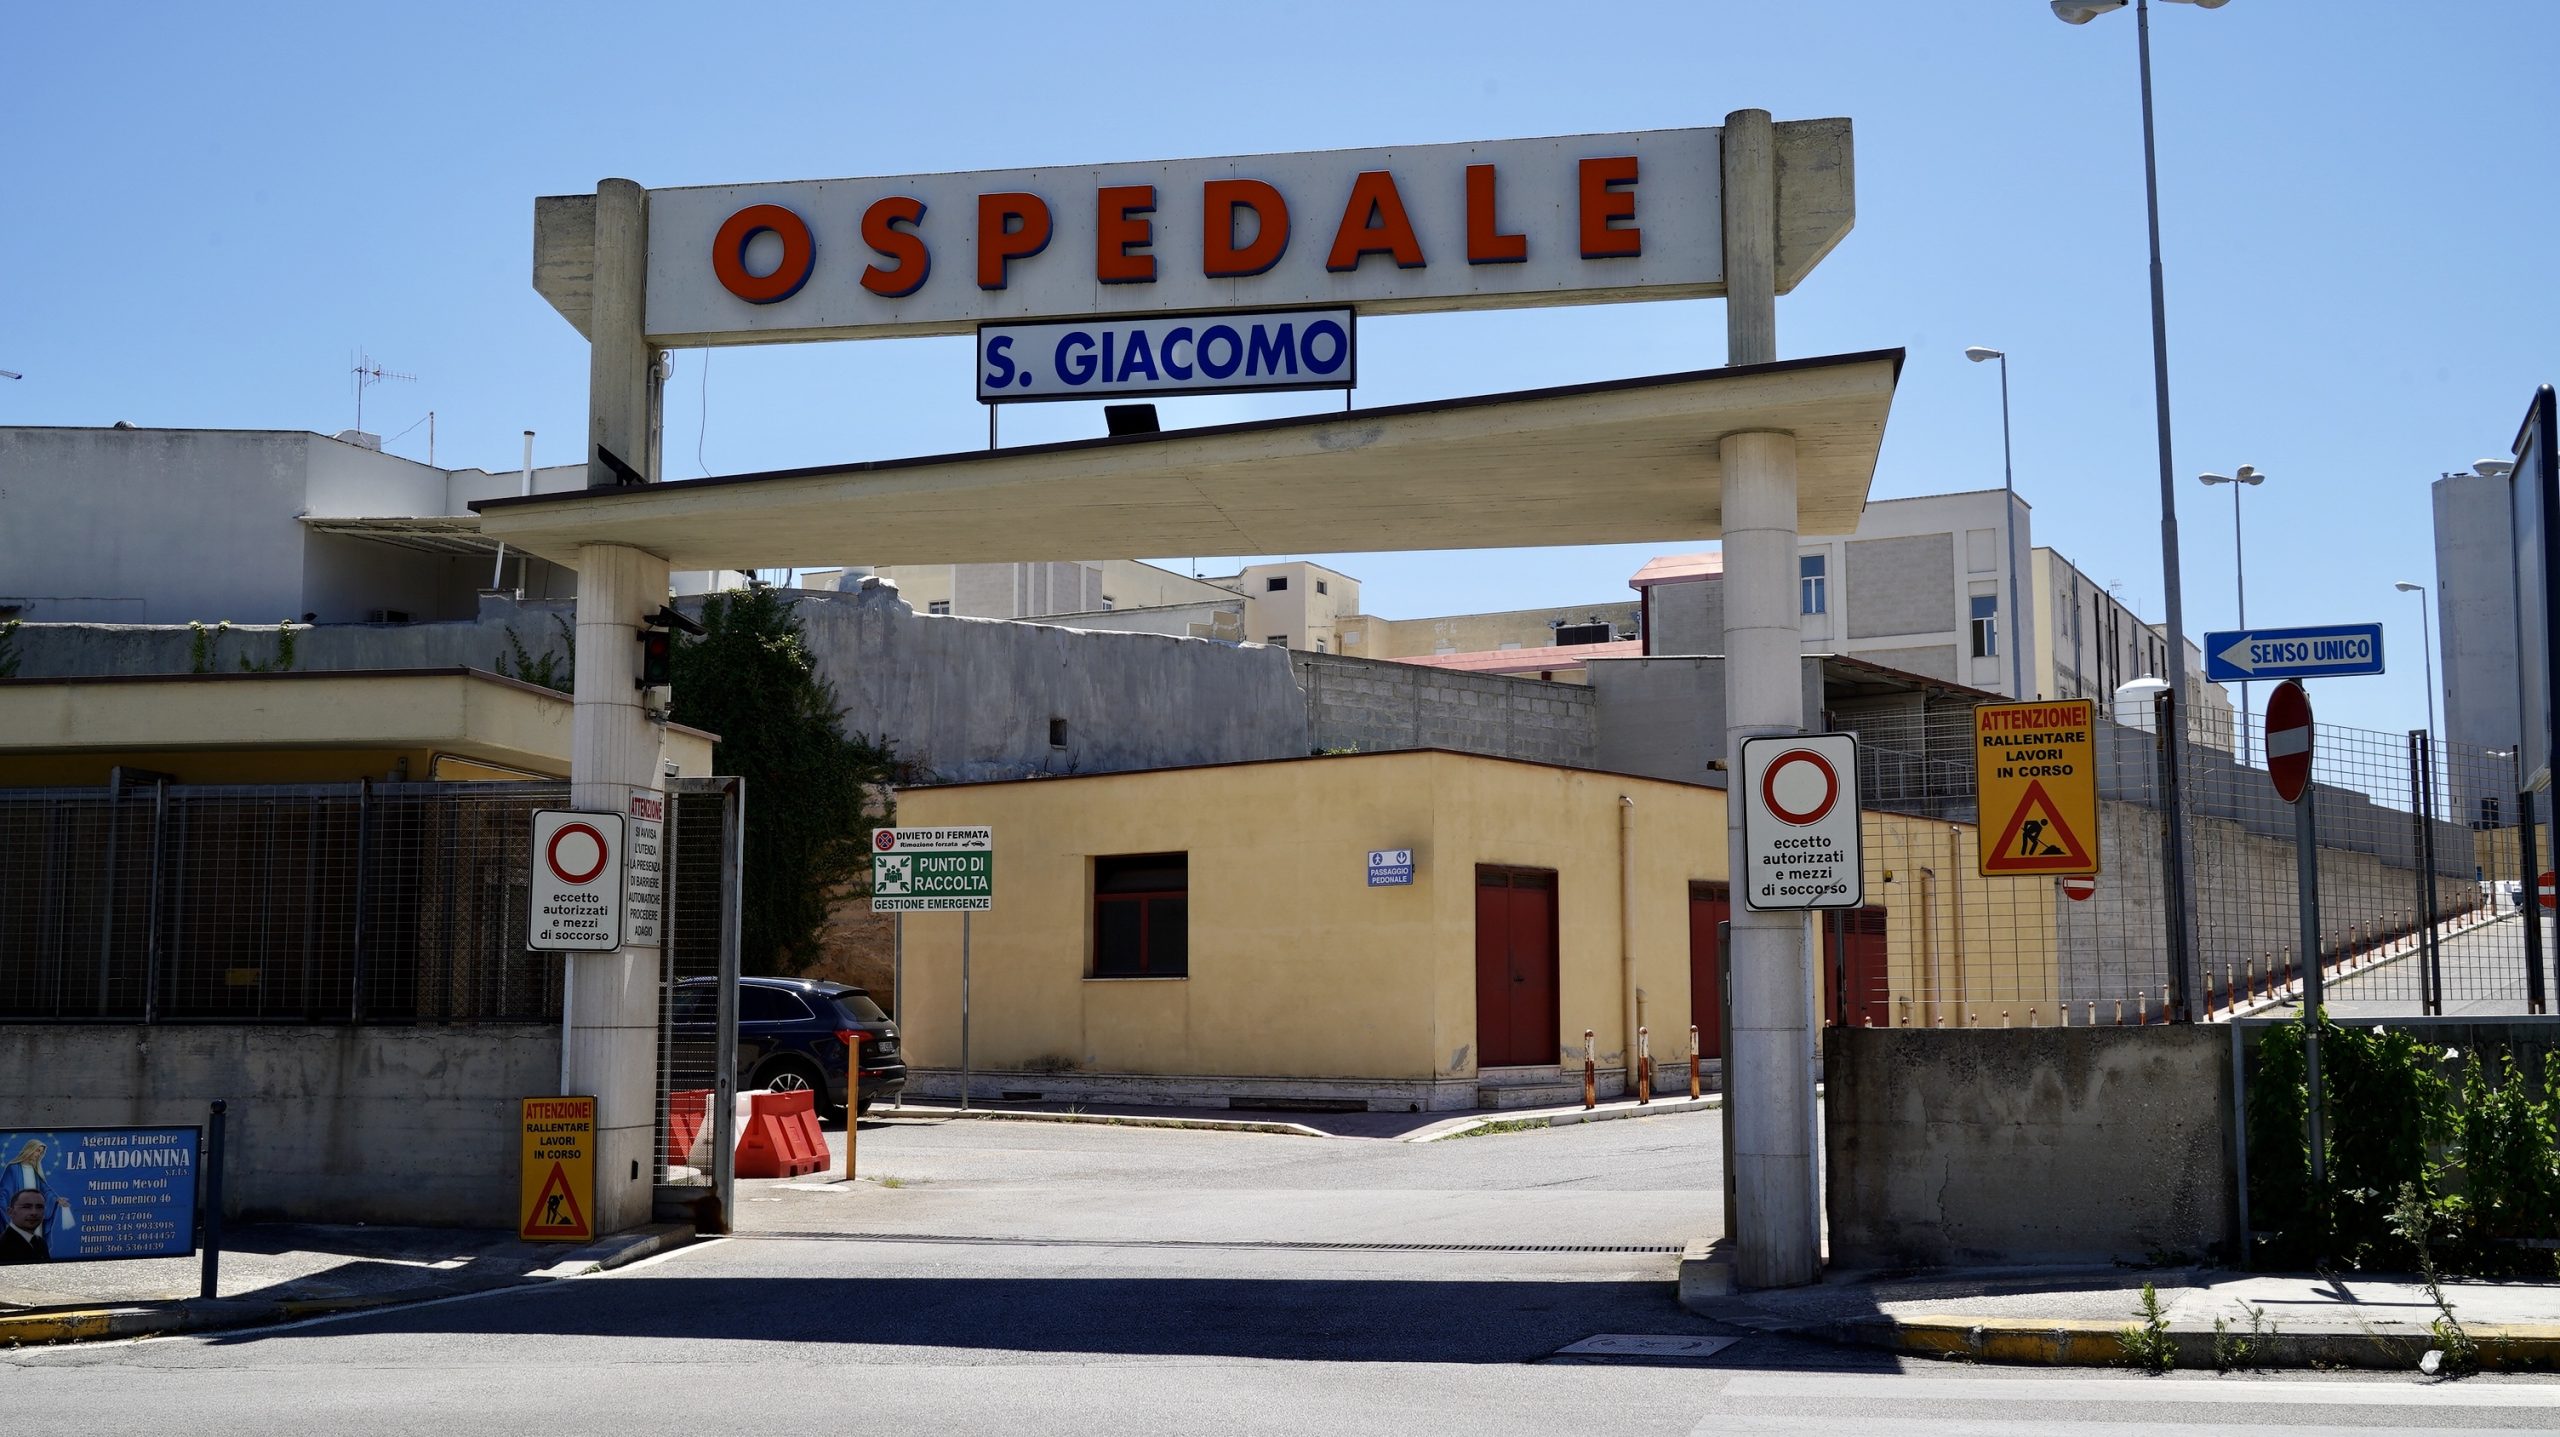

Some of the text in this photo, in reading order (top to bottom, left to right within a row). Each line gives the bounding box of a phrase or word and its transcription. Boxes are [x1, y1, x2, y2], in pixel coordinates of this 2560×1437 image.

[712, 156, 1642, 305] OSPEDALE
[985, 319, 1348, 389] S. GIACOMO
[2251, 639, 2369, 664] SENSO UNICO
[1981, 706, 2087, 731] ATTENZIONE!
[1983, 732, 2085, 746] RALLENTARE
[2006, 749, 2063, 762] LAVORI
[1997, 764, 2073, 778] IN CORSO
[631, 796, 662, 819] ATTENZIONE
[635, 826, 656, 839] SI AVVISA
[896, 832, 932, 840] DIVIETO
[947, 831, 989, 839] FERMATA
[1774, 835, 1831, 849] eccetto
[635, 843, 656, 855] L'UTENZA
[1763, 850, 1843, 865] autorizzati
[630, 857, 660, 872] LA PRESENZA
[920, 857, 984, 872] PUNTO DI
[1371, 868, 1408, 876] PASSAGGIO
[1776, 867, 1832, 880] e mezzi
[631, 876, 659, 889] DI BARRIERE
[914, 876, 988, 890] RACCOLTA
[1762, 884, 1847, 896] di soccorso
[553, 892, 599, 902] eccetto
[629, 891, 660, 904] AUTOMATICHE
[543, 905, 608, 916] autorizzati
[874, 899, 989, 909] GESTIONE EMERGENZE
[630, 908, 658, 921] PROCEDERE
[553, 918, 598, 928] e mezzi
[540, 930, 608, 941] di soccorso
[635, 925, 652, 937] ADAGIO
[526, 1102, 591, 1119] ATTENZIONE!
[527, 1123, 589, 1132] RALLENTARE
[82, 1135, 177, 1147] Agenzia Funebre
[540, 1137, 575, 1145] LAVORI
[67, 1149, 190, 1170] LA MADONNINA
[534, 1150, 581, 1159] IN CORSO
[89, 1179, 167, 1191] Mimmo Mevoli
[83, 1194, 171, 1205] Via S. Domenico 46
[81, 1224, 113, 1232] Cosimo
[81, 1234, 113, 1243] Mimmo
